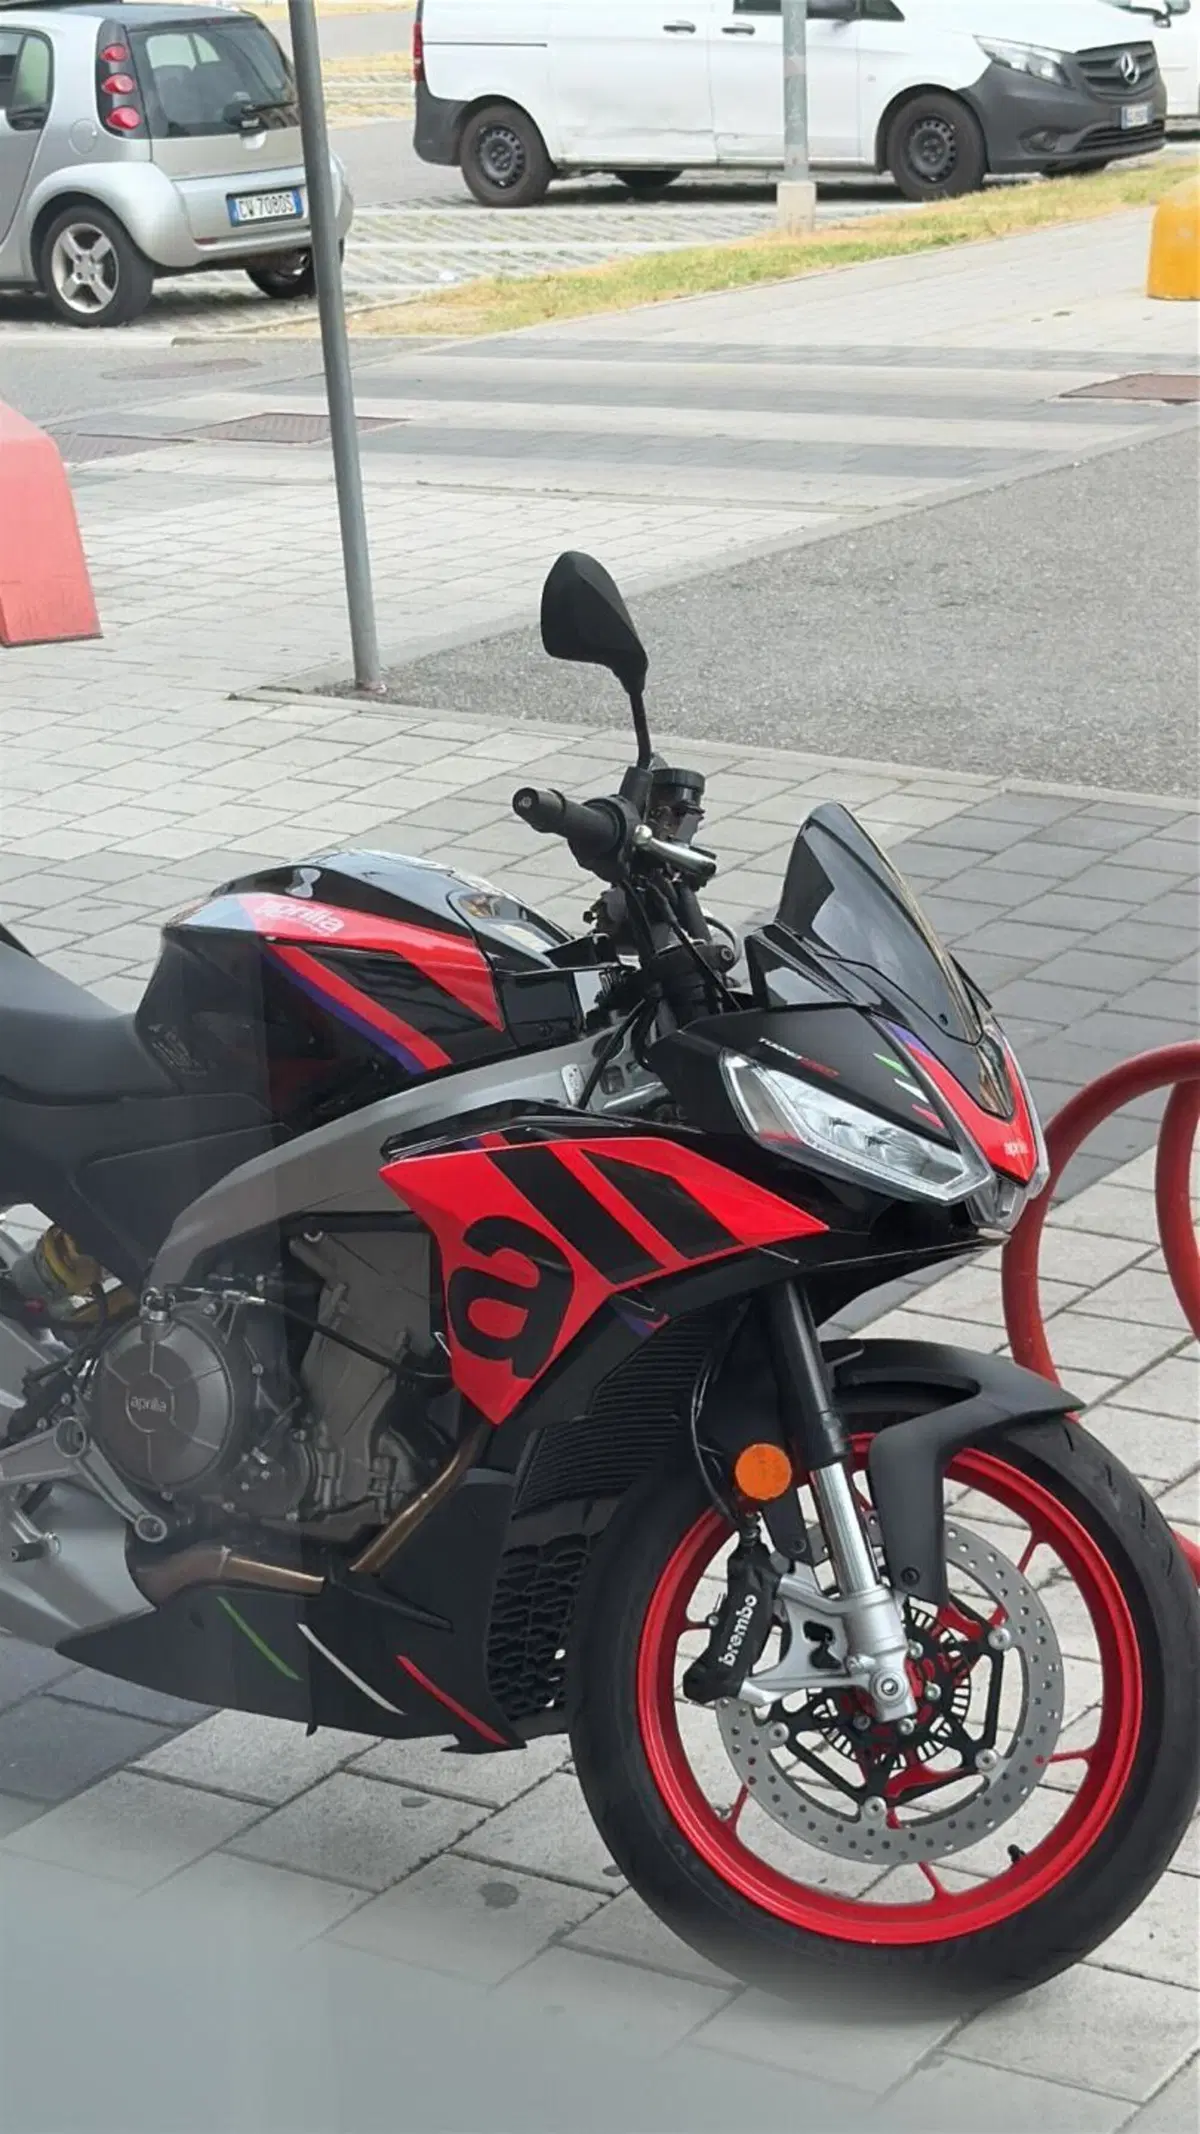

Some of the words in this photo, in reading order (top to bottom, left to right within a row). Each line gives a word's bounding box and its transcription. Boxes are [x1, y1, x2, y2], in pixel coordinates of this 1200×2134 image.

[448, 1215, 574, 1379] a
[130, 1396, 167, 1412] aprilia
[718, 1594, 758, 1668] brembo
